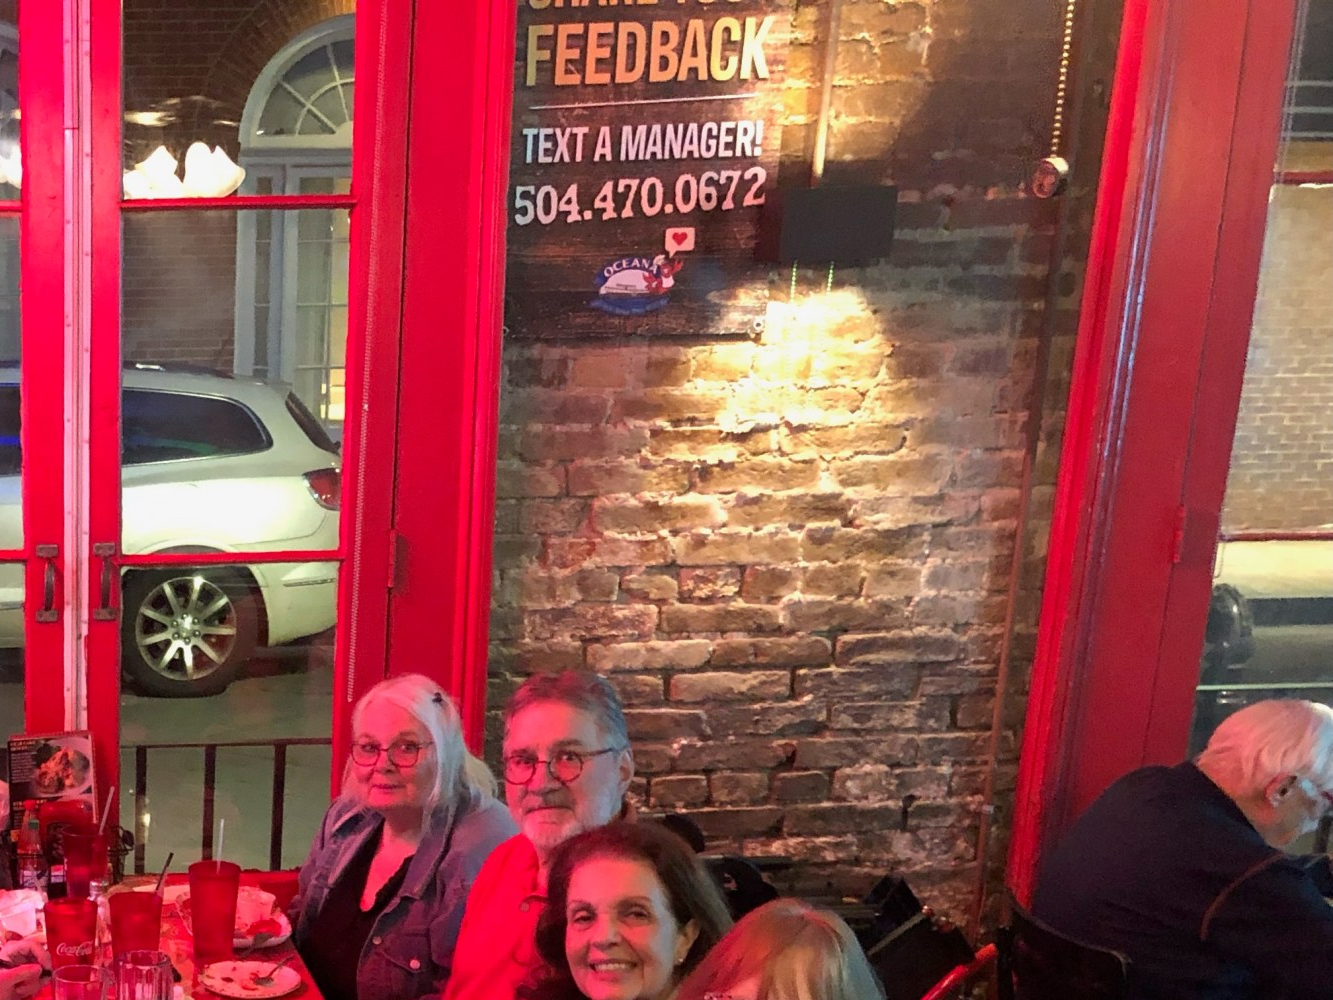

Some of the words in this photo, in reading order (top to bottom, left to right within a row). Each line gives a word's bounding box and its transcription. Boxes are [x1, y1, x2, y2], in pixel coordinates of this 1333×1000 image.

[526, 16, 774, 87] FEEDBACK
[523, 126, 589, 164] TEXT
[593, 125, 613, 163] A
[620, 119, 764, 163] MANAGER!
[515, 166, 767, 226] 504.470.0672
[603, 257, 659, 278] OCEANA
